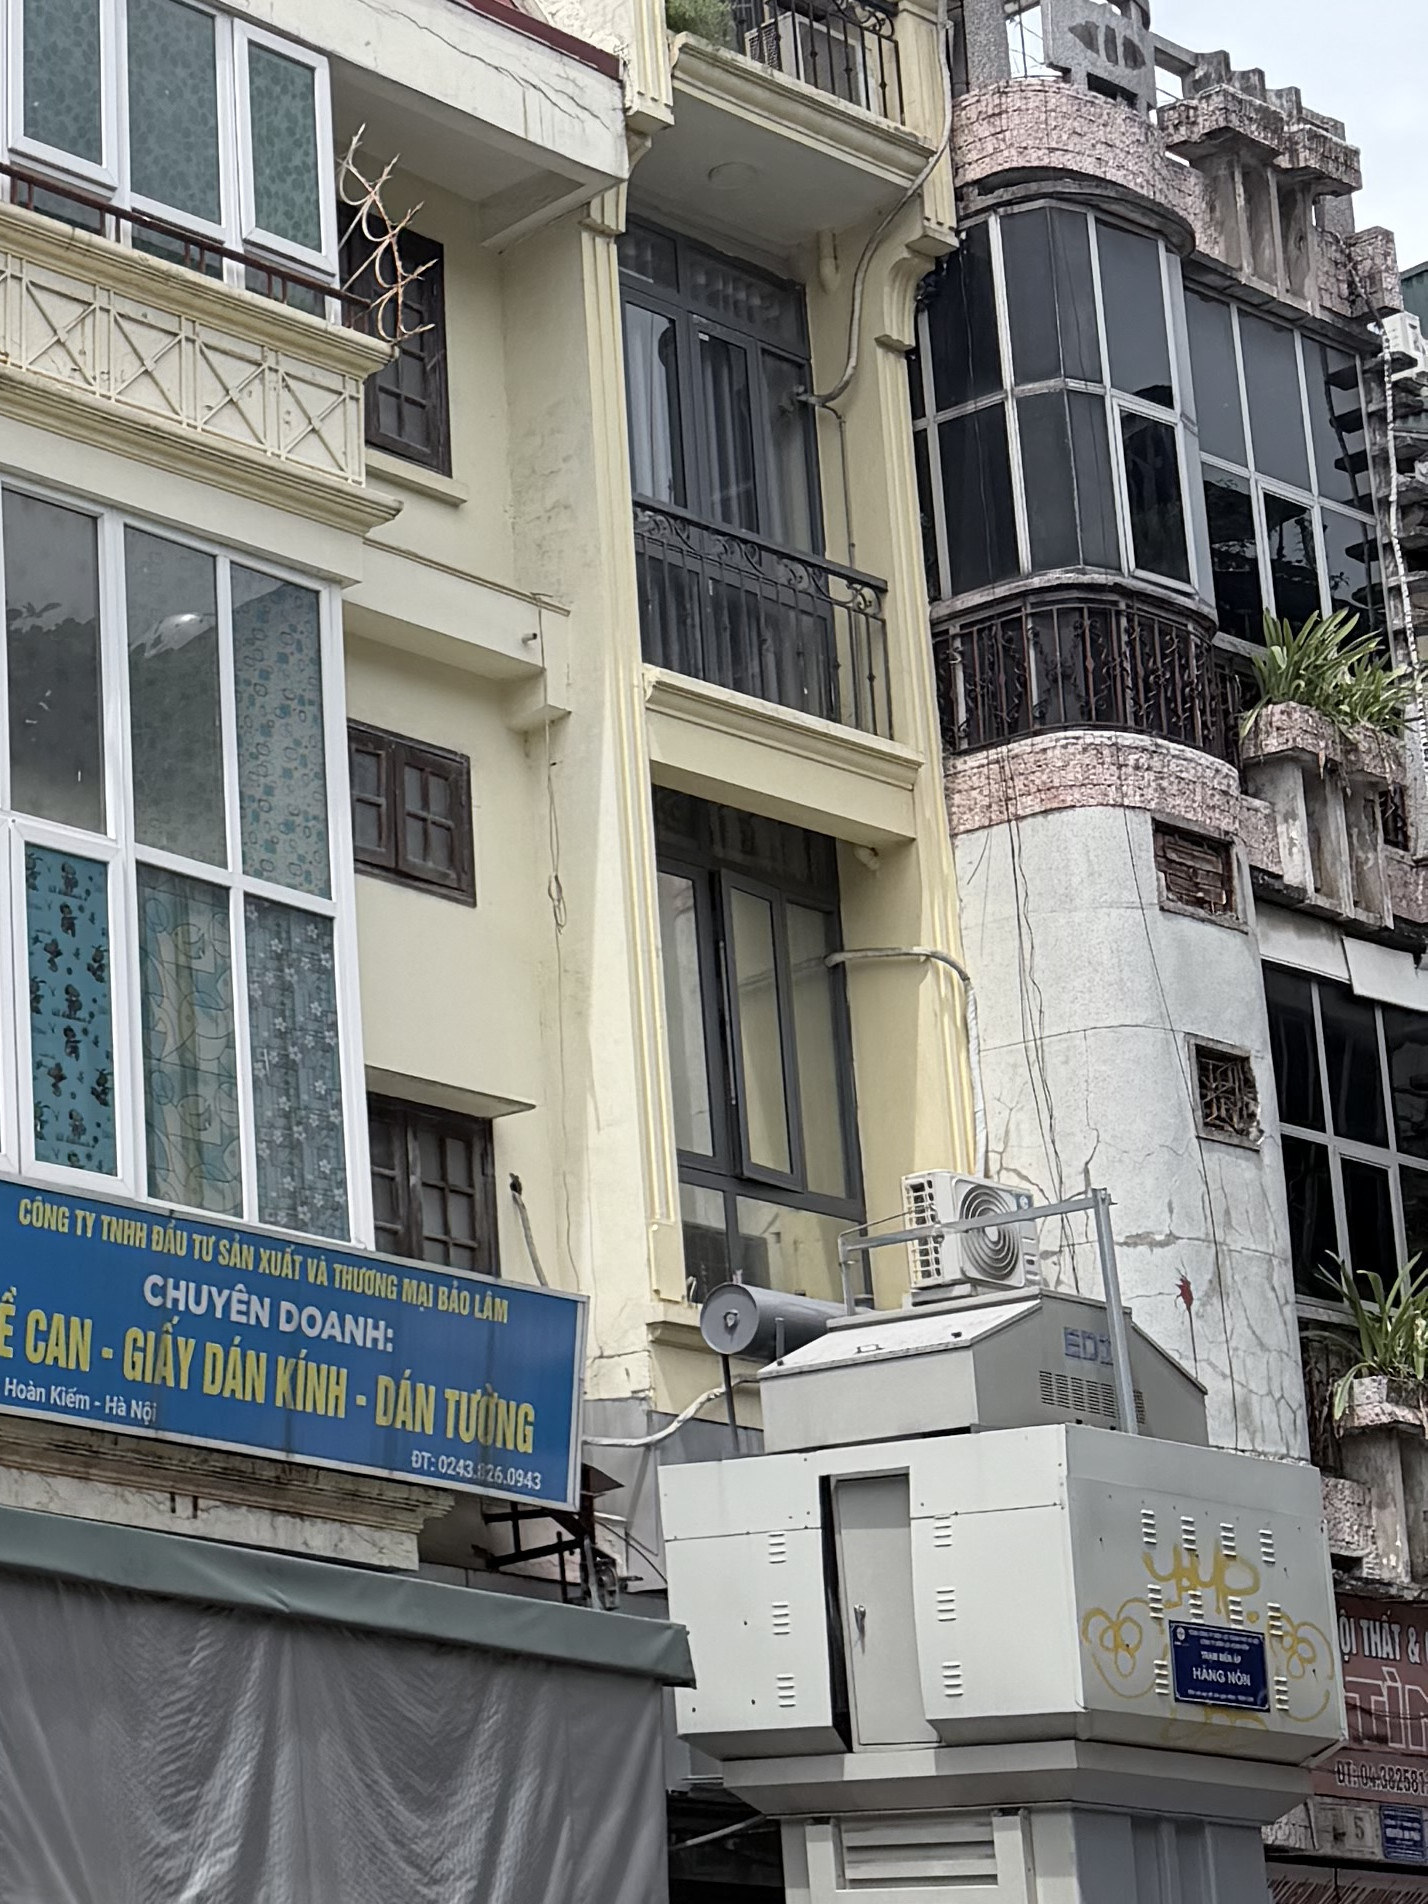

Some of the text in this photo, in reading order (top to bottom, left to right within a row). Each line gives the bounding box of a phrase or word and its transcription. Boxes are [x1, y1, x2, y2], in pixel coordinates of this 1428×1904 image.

[18, 1196, 508, 1324] CÔNG TY TNHH ĐẦU TƯ SẢN XUẤT VÀ THƯƠNG MẠI BẢO LÂM
[143, 1273, 395, 1354] CHUYÊN DOANH:
[4, 1377, 45, 1404] Hoàn
[49, 1382, 90, 1412] Kiếm
[105, 1395, 127, 1417] Hà
[131, 1398, 157, 1425] Nội
[25, 1308, 93, 1372] CAN
[123, 1315, 196, 1391] GIẤY
[203, 1335, 267, 1404] DÁN
[275, 1348, 348, 1419] KÍNH
[375, 1368, 436, 1436] DÁN
[444, 1383, 536, 1454] TƯỜNG
[411, 1450, 436, 1471] ĐT:
[1339, 1609, 1421, 1664] ỘI THẤT &
[1354, 1816, 1364, 1840] 5
